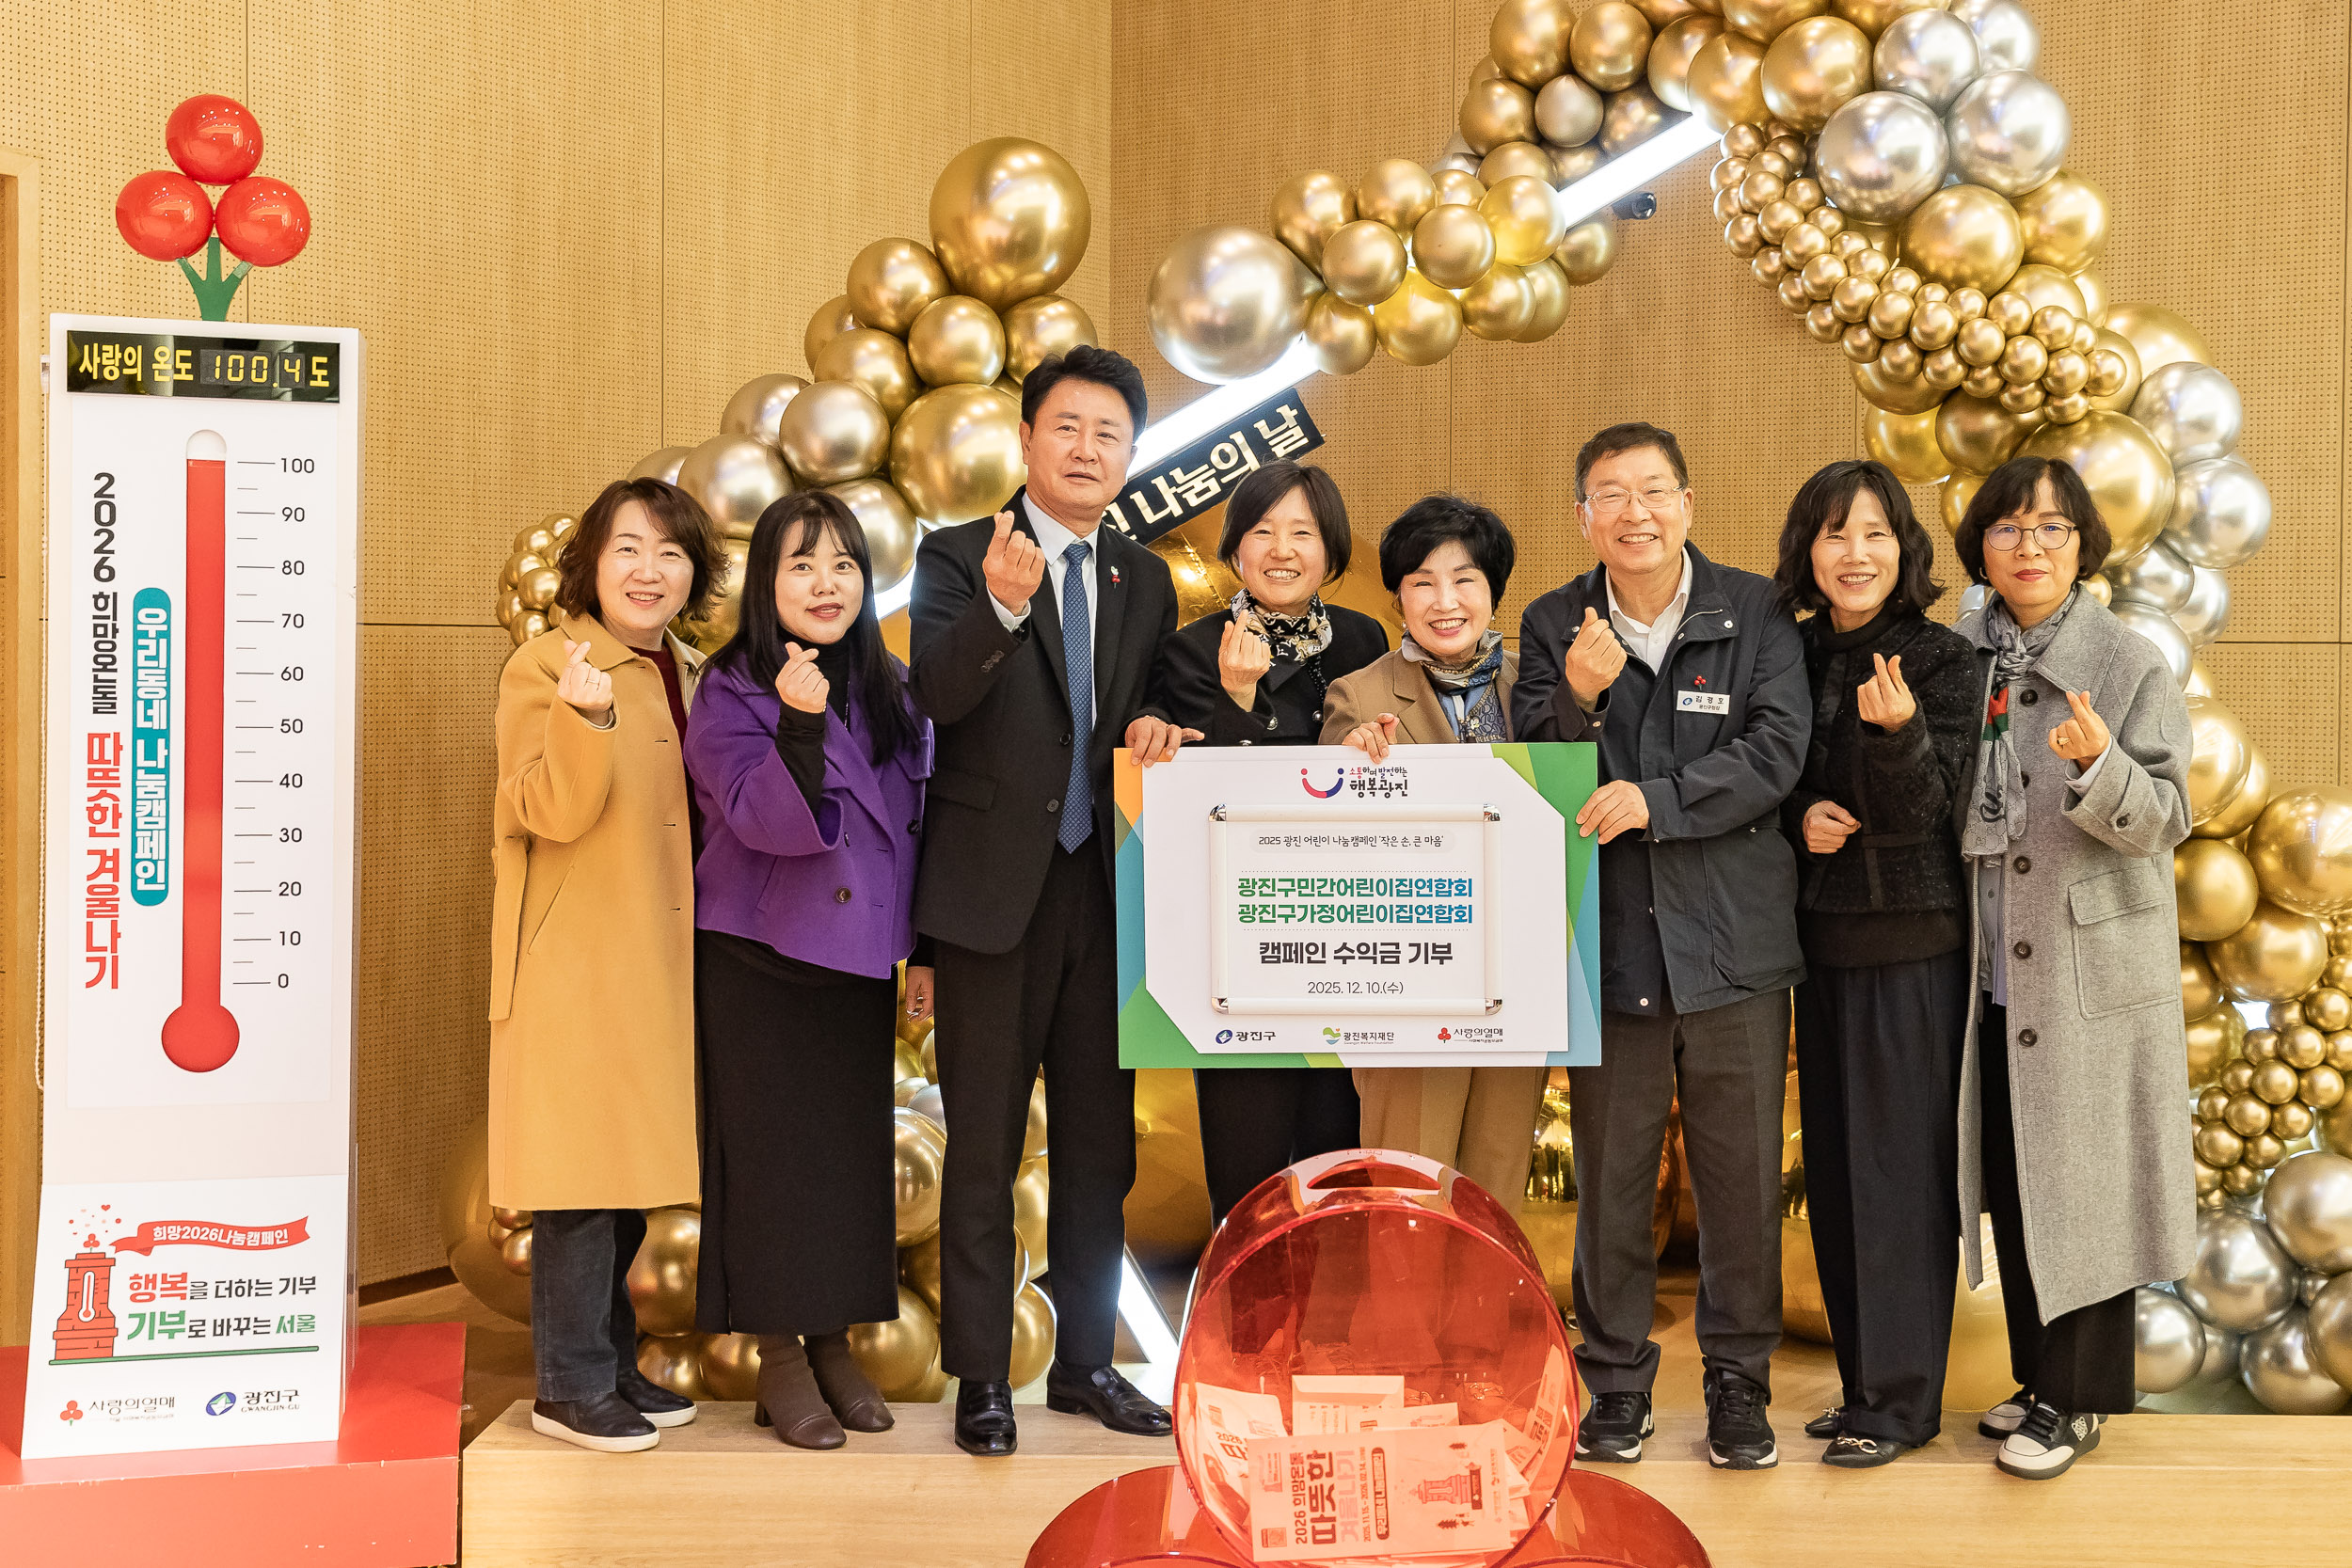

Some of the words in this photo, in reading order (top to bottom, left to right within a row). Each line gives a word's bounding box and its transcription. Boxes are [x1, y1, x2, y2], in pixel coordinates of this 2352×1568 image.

[79, 342, 143, 382] 사랑의
[151, 345, 194, 381] 온도
[215, 355, 301, 388] 100.4
[310, 356, 329, 388] 도
[280, 458, 315, 473] 100
[1130, 430, 1261, 524] 나눔의
[1253, 404, 1309, 458] 날
[281, 507, 306, 523] 90
[93, 472, 117, 583] 2026
[281, 561, 305, 576] 80
[281, 614, 305, 629] 70
[91, 591, 119, 714] 희망온돌
[136, 607, 168, 730] 우리동네
[280, 667, 304, 682] 60
[279, 720, 304, 734] 50
[278, 774, 304, 788] 40
[1349, 767, 1376, 779] 소통하며
[1378, 767, 1407, 779] 발전하는
[85, 732, 123, 838] 따뜻한
[1349, 777, 1407, 799] 행복광진
[135, 737, 168, 891] 나눔캠페인
[278, 828, 303, 843] 30
[1259, 836, 1281, 846] 2025
[1283, 835, 1301, 847] 광진
[1303, 835, 1329, 847] 어린이
[1400, 835, 1411, 847] 손,
[1413, 836, 1422, 847] 큰
[278, 882, 302, 896] 20
[1238, 878, 1472, 898] 광진구민간어린이집연합회
[85, 847, 121, 990] 겨울나기
[1238, 904, 1472, 924] 광진구가정어린이집연합회
[279, 931, 301, 946] 10
[1259, 942, 1327, 964] 캠페인
[1333, 942, 1401, 965] 수익금
[1408, 942, 1454, 965] 기부
[278, 974, 289, 989] 0
[1308, 982, 1343, 994] 2025.
[1346, 982, 1363, 994] 12.
[1366, 981, 1404, 995] 10.(수)
[1235, 1031, 1277, 1042] 광진구
[1343, 1032, 1394, 1041] 광진복지재단
[1454, 1028, 1503, 1038] 사랑의열매
[153, 1226, 289, 1246] 희망2026나눔캠페인
[129, 1272, 208, 1303] 행복을
[215, 1278, 273, 1298] 더하는
[278, 1276, 316, 1295] 기부
[127, 1310, 206, 1340] 기부로
[213, 1317, 271, 1337] 바꾸는
[276, 1314, 316, 1334] 서울
[243, 1389, 299, 1404] 광진구
[89, 1397, 174, 1415] 사랑의열매
[241, 1404, 300, 1413] GWANGJIN-GU
[1307, 1449, 1336, 1544] 따뜻한
[1295, 1510, 1308, 1544] 2026
